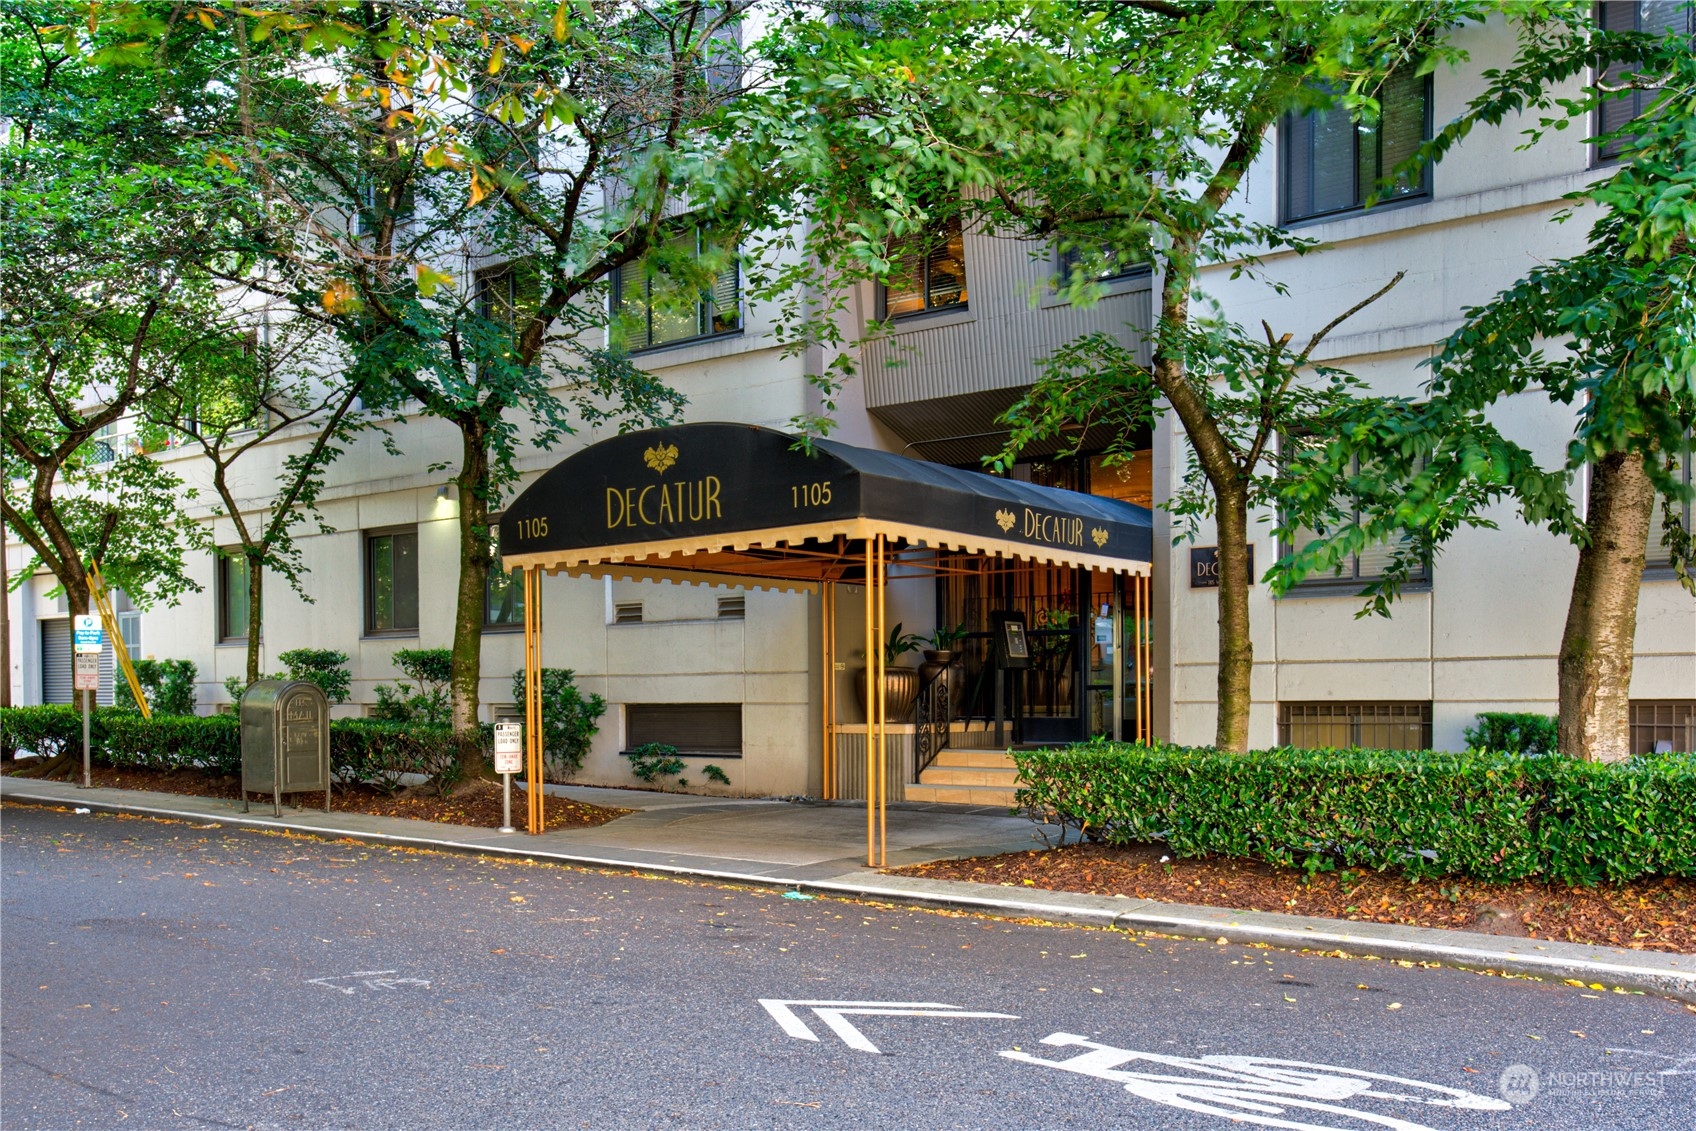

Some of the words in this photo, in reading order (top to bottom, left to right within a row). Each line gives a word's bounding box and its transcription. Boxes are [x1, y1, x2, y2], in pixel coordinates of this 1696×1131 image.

[606, 476, 722, 529] DECATUR
[792, 481, 832, 509] 1105
[517, 517, 549, 540] 1105
[1024, 507, 1083, 547] DECATUR
